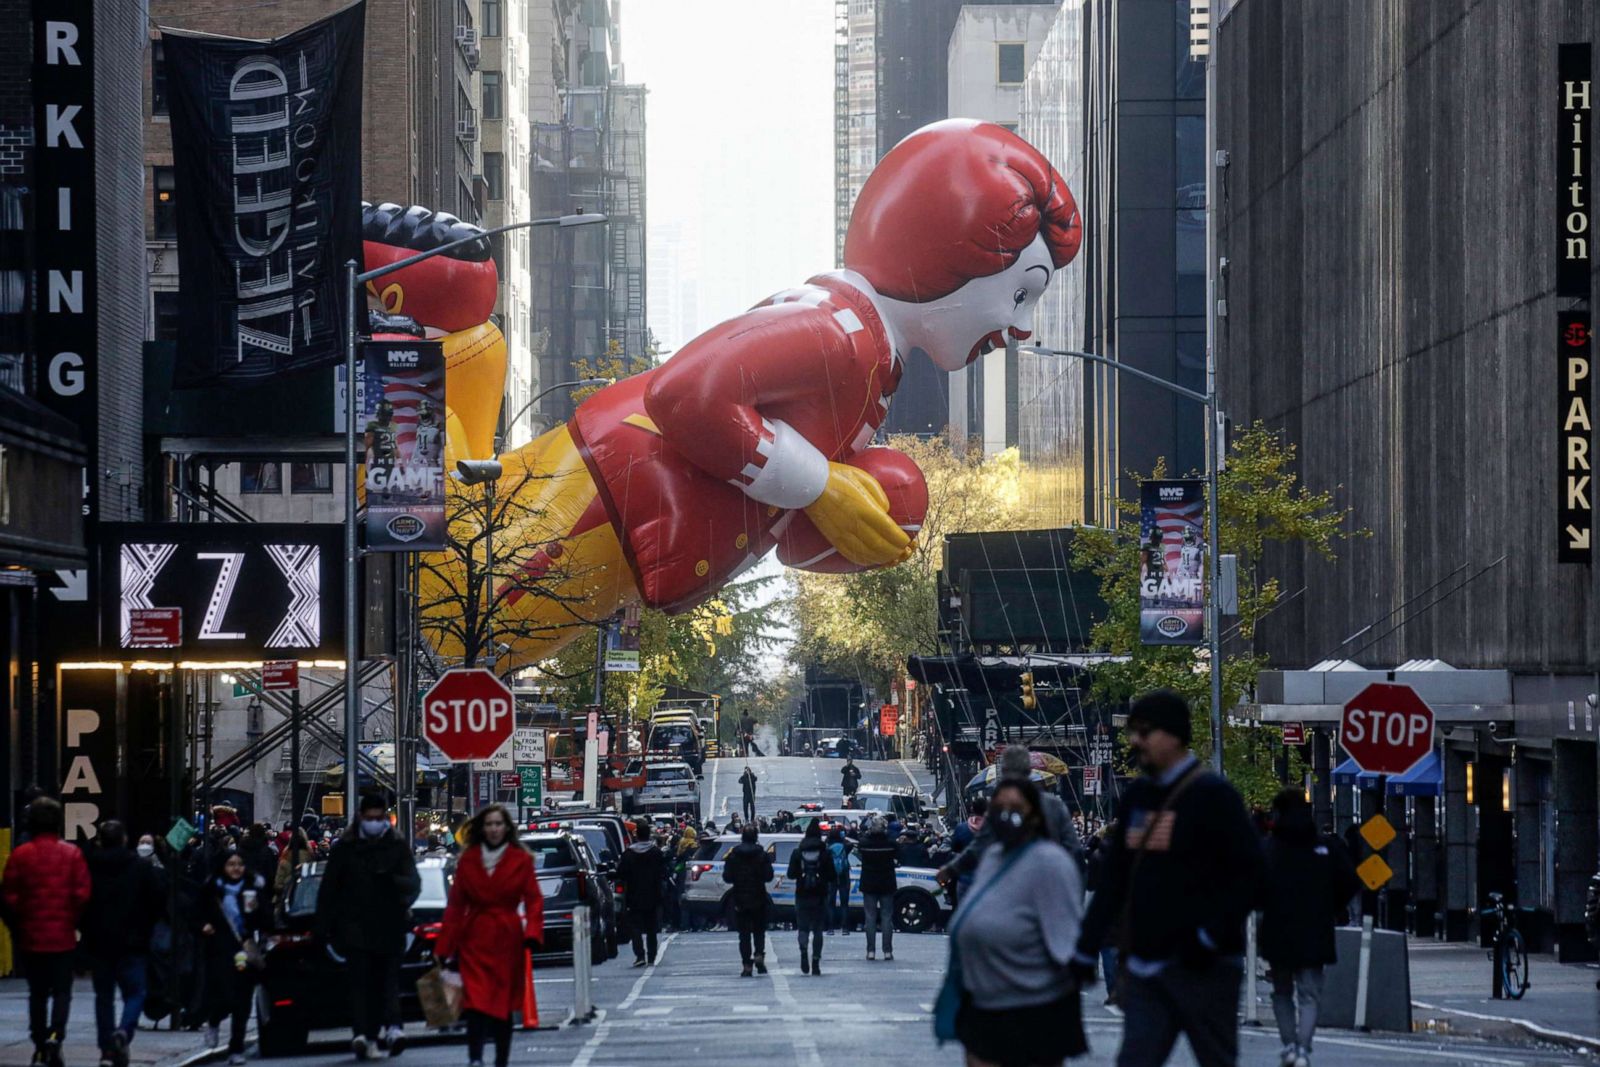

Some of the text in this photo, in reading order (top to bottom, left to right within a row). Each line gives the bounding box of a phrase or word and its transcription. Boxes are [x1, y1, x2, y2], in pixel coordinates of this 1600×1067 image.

[229, 54, 294, 362] ZIEGFELD
[294, 88, 317, 307] BALLROOM
[1564, 80, 1591, 259] Hilton
[388, 351, 419, 362] NYC
[1564, 357, 1591, 510] PARK
[1159, 487, 1184, 497] NYC
[197, 552, 246, 640] Z
[429, 698, 509, 735] STOP
[984, 708, 998, 751] PARK
[1346, 708, 1429, 748] STOP
[61, 709, 102, 841] PAR
